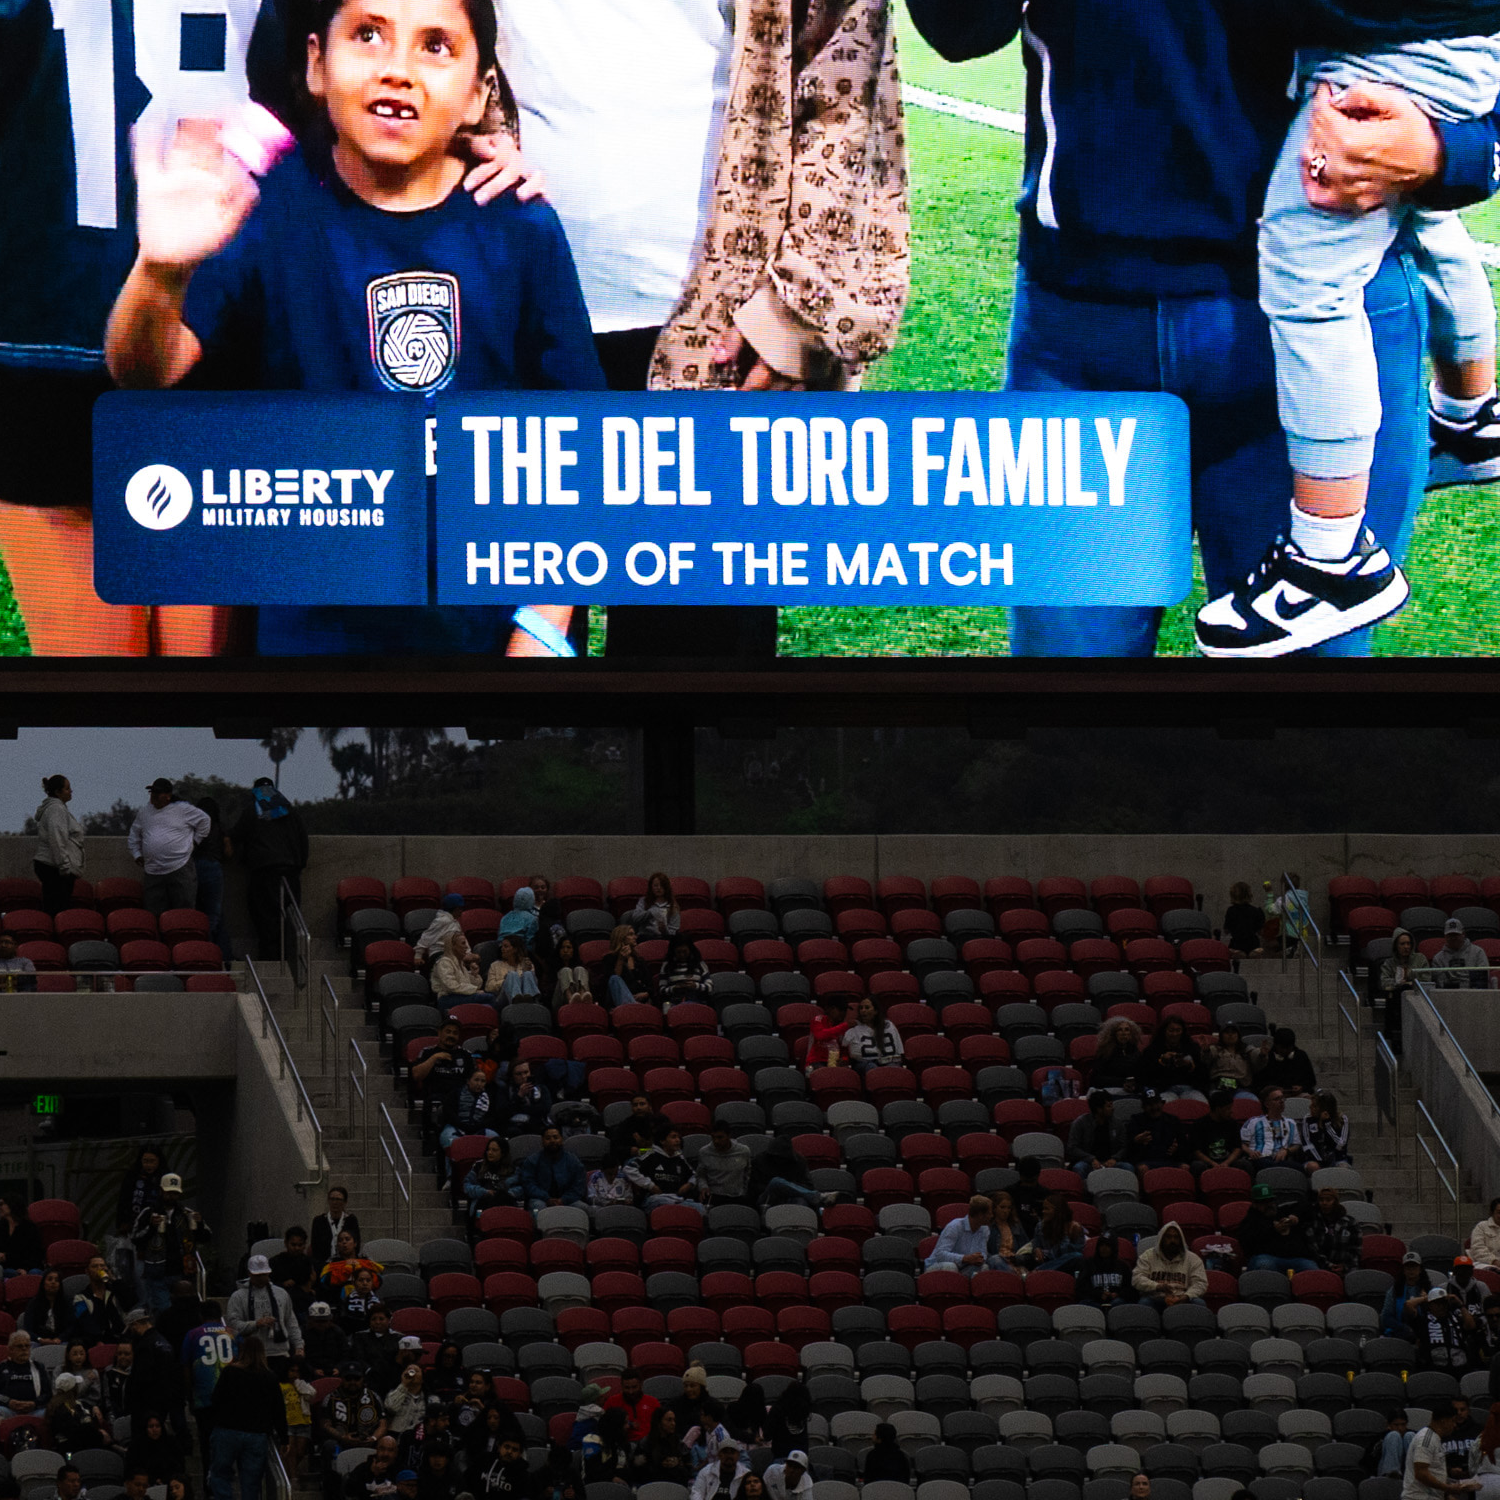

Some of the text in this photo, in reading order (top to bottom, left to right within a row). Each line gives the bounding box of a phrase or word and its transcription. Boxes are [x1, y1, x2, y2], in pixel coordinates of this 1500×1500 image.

[376, 283, 451, 313] SAN DIEGO
[461, 416, 1139, 507] THE DEL TORO FAMILY
[201, 468, 395, 504] LIBERTY
[201, 508, 385, 527] MILITARY HOUSING
[466, 541, 1015, 587] HERO OF THE MATCH
[36, 1094, 61, 1114] EXIT
[198, 1334, 234, 1367] 30
[10, 1374, 33, 1382] DIRECT
